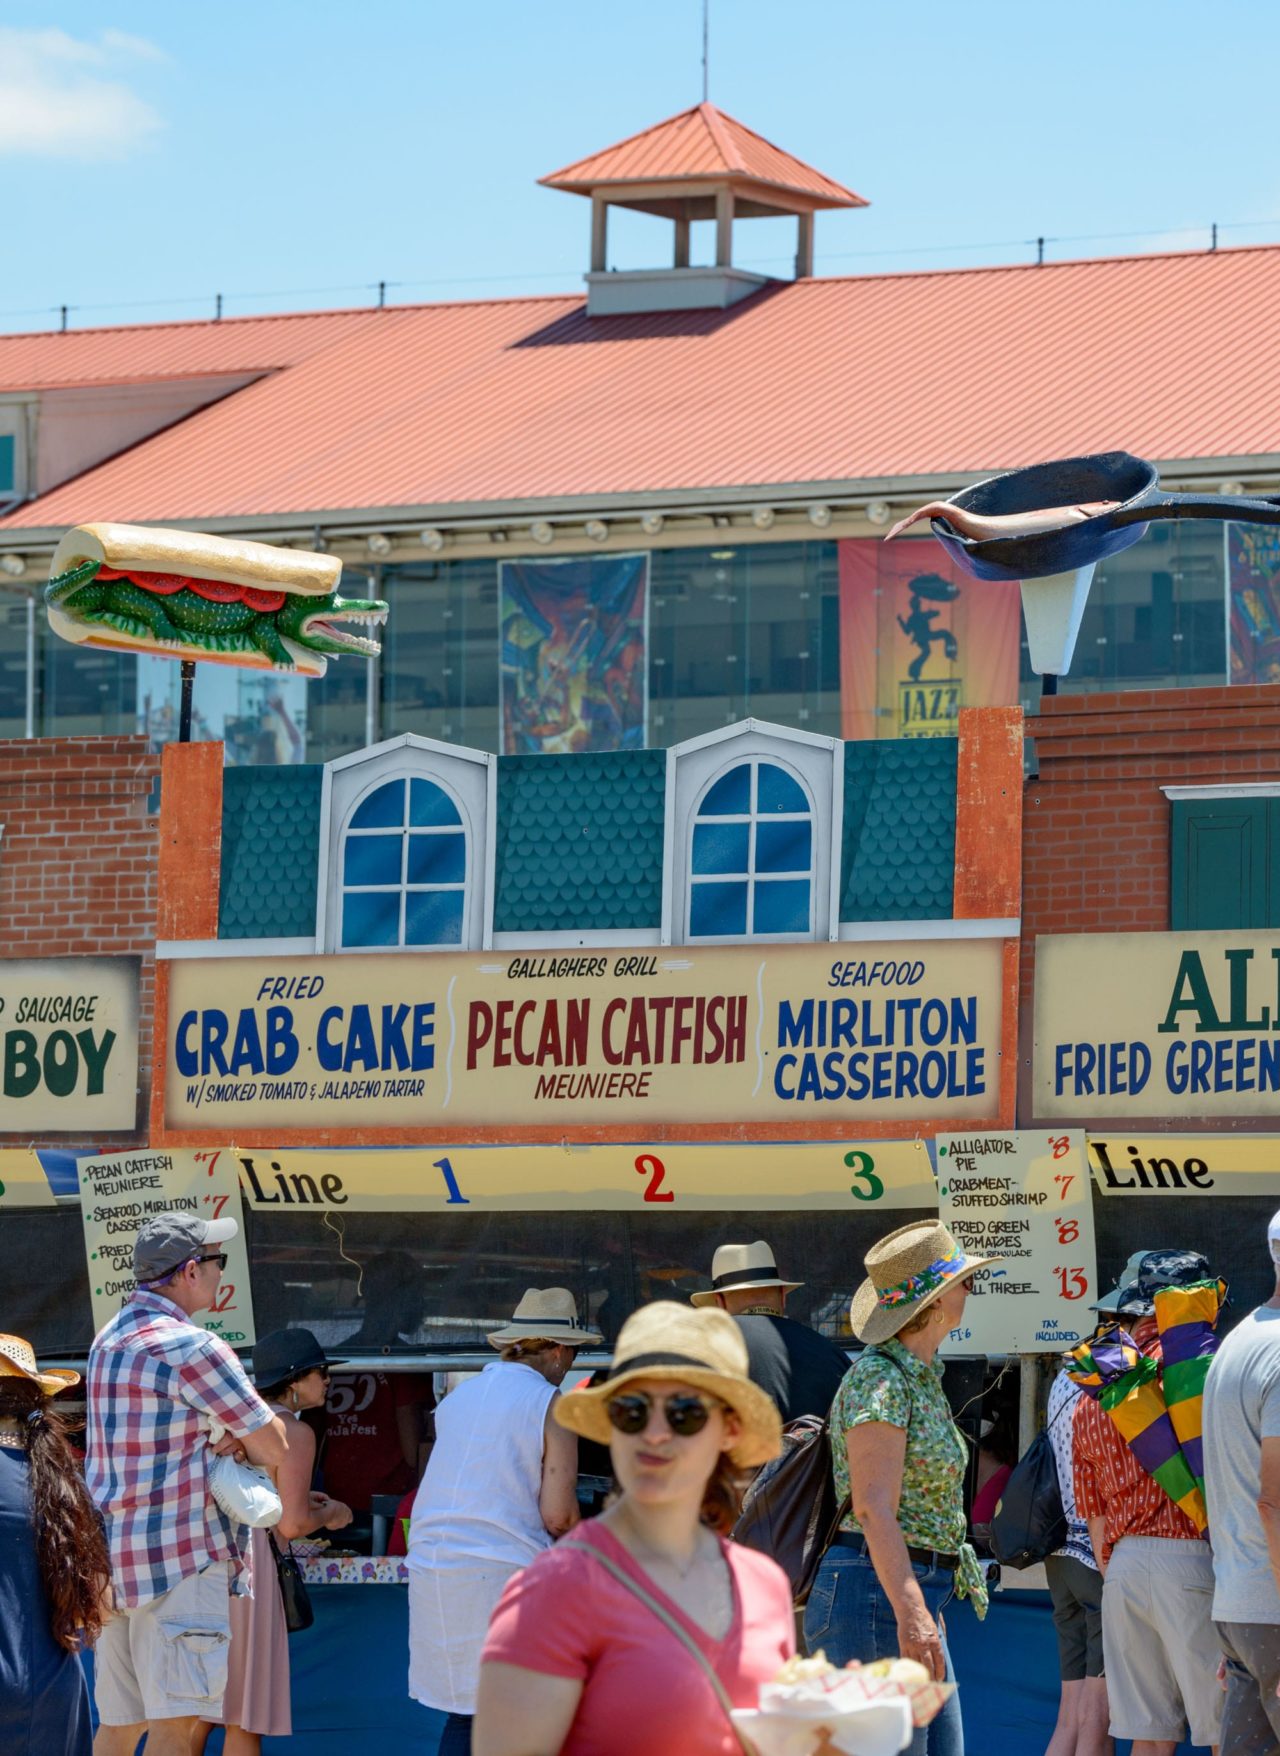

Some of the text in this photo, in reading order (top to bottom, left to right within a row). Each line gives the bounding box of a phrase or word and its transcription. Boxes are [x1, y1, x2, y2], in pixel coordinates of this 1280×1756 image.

[902, 688, 958, 725] JAZZ
[507, 956, 658, 978] GALLAGHERS GRILL
[828, 961, 925, 987] SEAFOOD
[257, 975, 324, 1000] FRIED
[15, 996, 98, 1023] SAUSAGE
[778, 996, 977, 1048] MIRLITON
[175, 1002, 435, 1077] CRAB CAKE
[466, 995, 748, 1070] PECAN CATFISH
[3, 1027, 117, 1098] BOY
[774, 1048, 985, 1101] CASSEROLE
[1055, 1042, 1151, 1096] FRIED
[260, 1081, 308, 1101] TOMATO
[318, 1080, 382, 1100] JALAPENO
[382, 1079, 425, 1097] TARTAR
[534, 1072, 652, 1099] MEUNIERE
[949, 1136, 1070, 1160] ALLIGATOR $8
[85, 1151, 221, 1181] PECAN CATFISH $7
[955, 1157, 977, 1171] PIE
[1091, 1143, 1214, 1188] Line
[94, 1175, 163, 1196] MEUNIERE
[240, 1151, 884, 1204] Line 1 2 3
[1054, 1175, 1075, 1200] $7
[94, 1195, 230, 1222] SEAFOOD MIRLITON $7
[952, 1192, 1048, 1207] STUFFED SHRIMP
[951, 1217, 1080, 1244] FRIED GREEN $8
[958, 1234, 1022, 1250] TOMATOES
[98, 1244, 134, 1259] FRIED
[988, 1282, 1039, 1294] THREE
[1052, 1266, 1088, 1300] $13
[204, 1320, 223, 1330] TAX
[1035, 1331, 1080, 1342] INCLUDED
[1042, 1320, 1058, 1329] TAX
